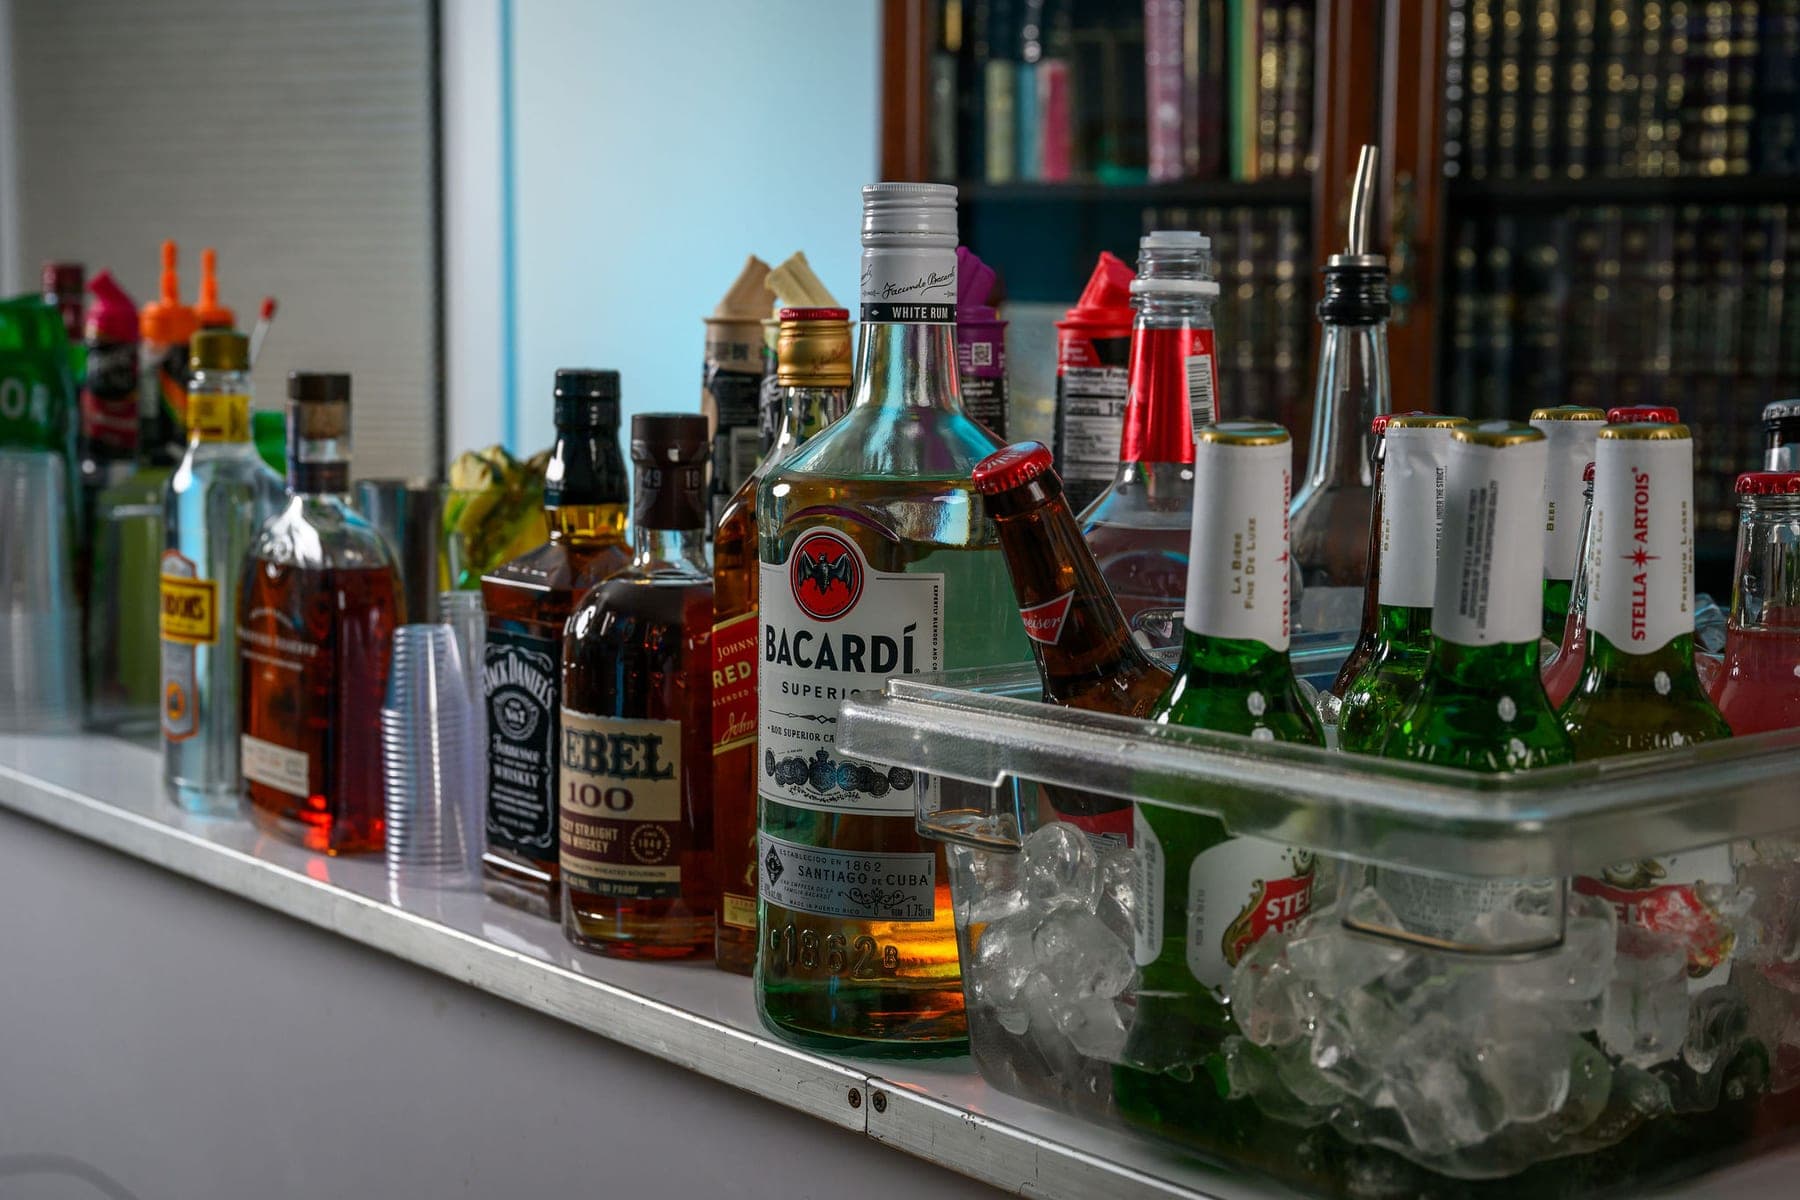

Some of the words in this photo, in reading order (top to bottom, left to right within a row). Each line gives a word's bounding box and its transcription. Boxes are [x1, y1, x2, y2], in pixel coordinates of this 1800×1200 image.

[892, 306, 927, 319] WHITE
[1436, 467, 1445, 488] STRICT
[1436, 487, 1444, 500] THE
[1632, 472, 1649, 544] ARTOIS
[1631, 572, 1647, 641] STELLA
[766, 622, 917, 674] BACARDÍ
[712, 660, 752, 689] RED
[783, 727, 821, 742] SUPERIOR
[823, 734, 835, 743] CA
[567, 781, 634, 813] 100
[574, 822, 619, 841] STRAIGHT
[798, 865, 868, 885] SANTIAGO
[886, 874, 928, 886] CUBA
[845, 860, 881, 872] 1862
